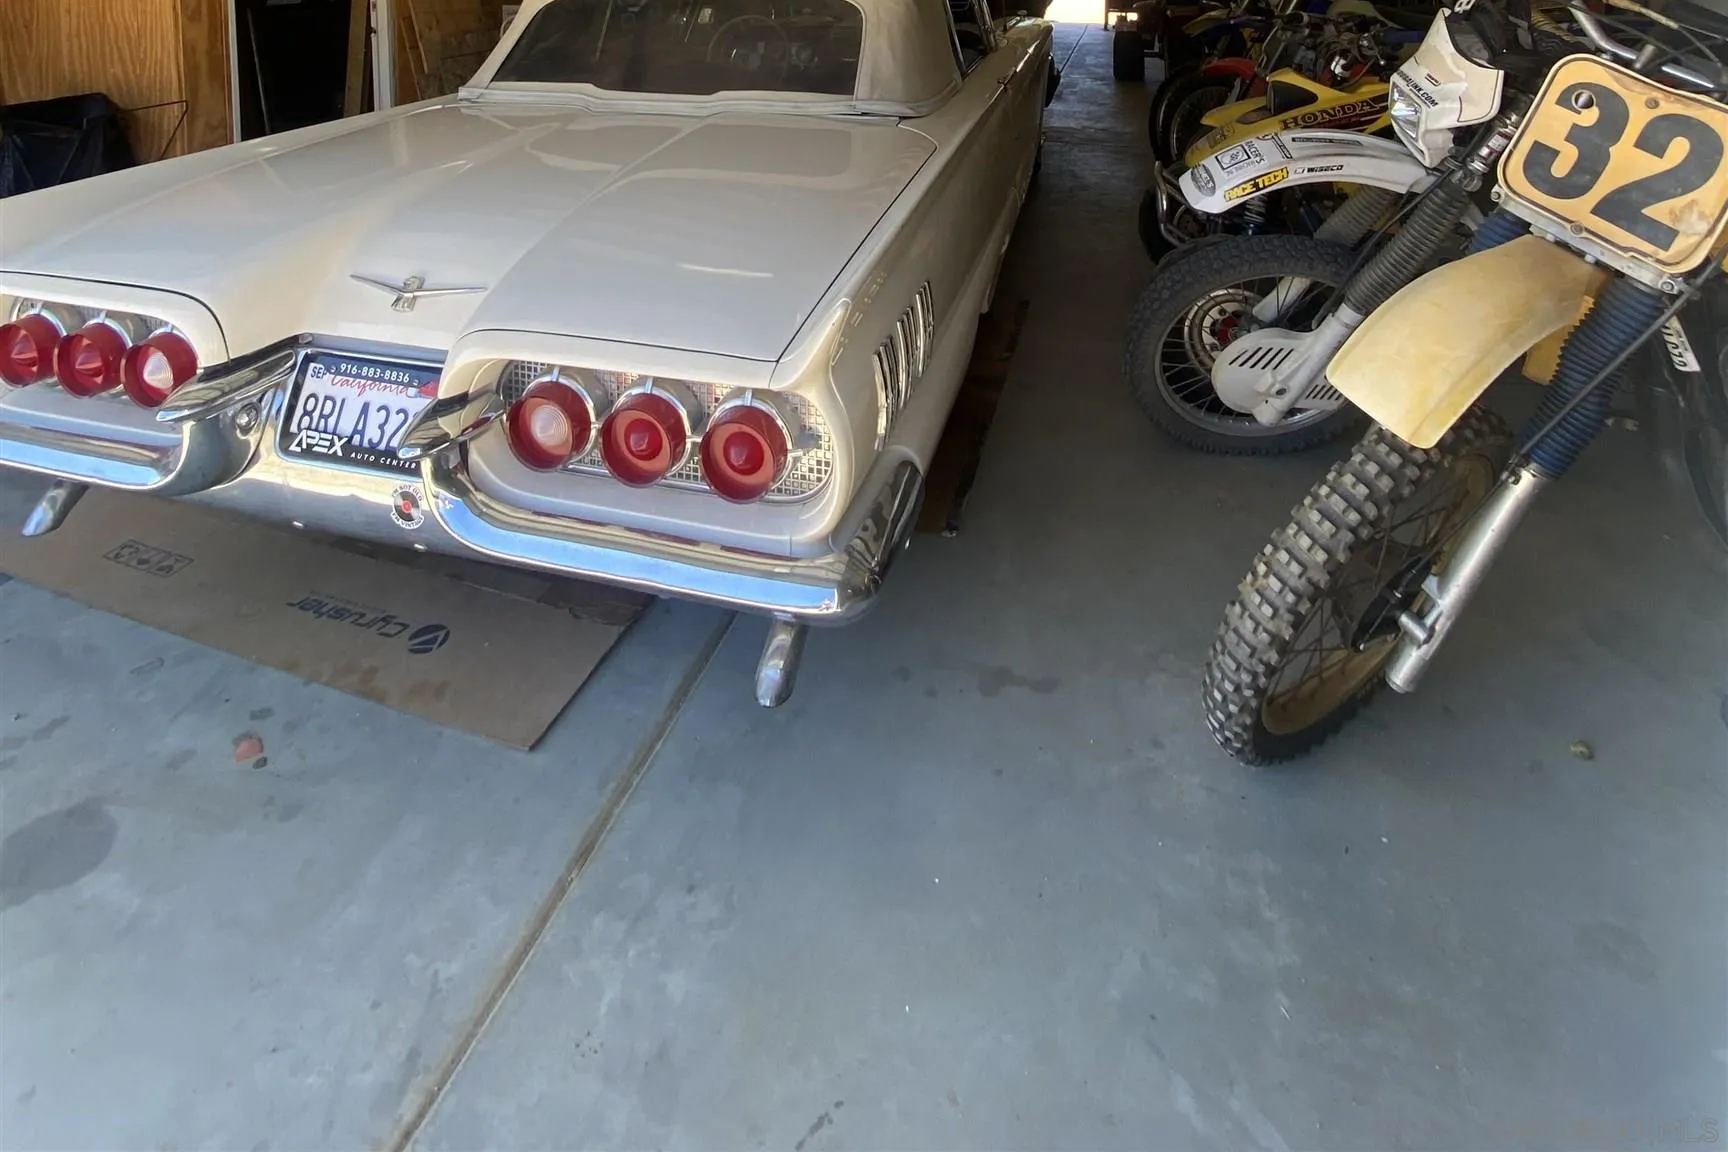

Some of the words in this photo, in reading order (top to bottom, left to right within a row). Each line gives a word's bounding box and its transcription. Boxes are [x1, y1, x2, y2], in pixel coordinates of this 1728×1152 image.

[1282, 99, 1380, 129] HONDA
[1306, 164, 1344, 175] WISECO
[1523, 82, 1724, 252] 32
[1225, 181, 1257, 202] RACE
[1256, 168, 1290, 190] TECH
[339, 362, 410, 383] 916-883-8836
[297, 392, 418, 452] 8RLA32
[288, 429, 349, 457] APEX
[350, 451, 376, 462] AUTO
[380, 457, 417, 470] CENTER
[285, 596, 411, 638] Cyrusher
